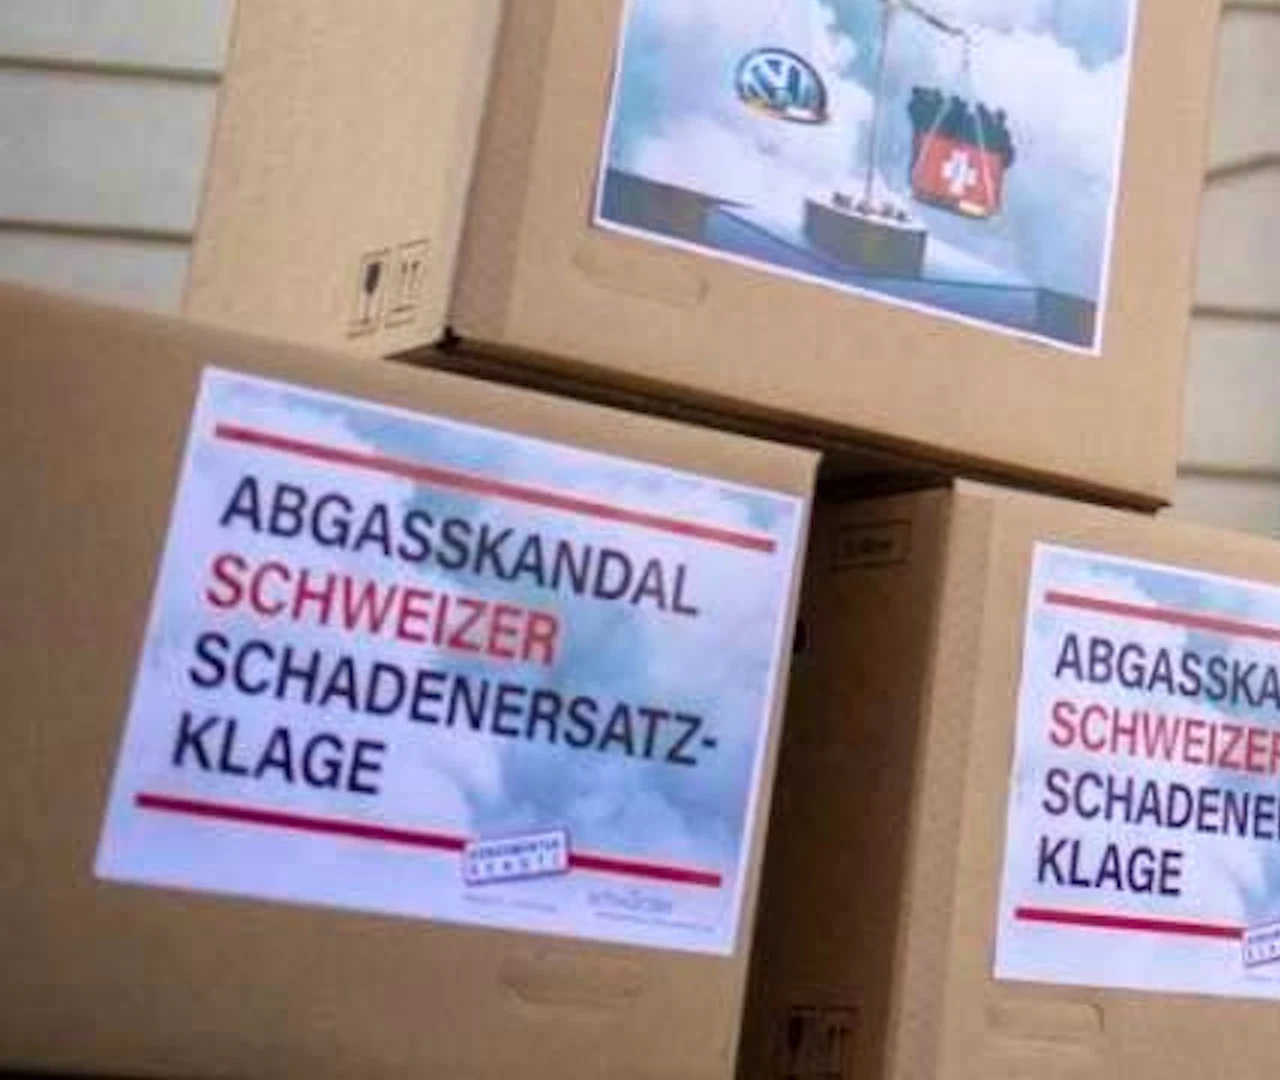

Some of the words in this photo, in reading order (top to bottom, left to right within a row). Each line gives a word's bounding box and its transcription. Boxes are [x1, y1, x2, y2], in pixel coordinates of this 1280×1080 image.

[221, 475, 701, 616] ABGASSKANDAL
[206, 554, 559, 667] SCHWEIZER
[174, 713, 386, 795] KLAGE
[189, 633, 717, 766] SCHADENERSATZ-
[1037, 835, 1183, 896] KLAGE
